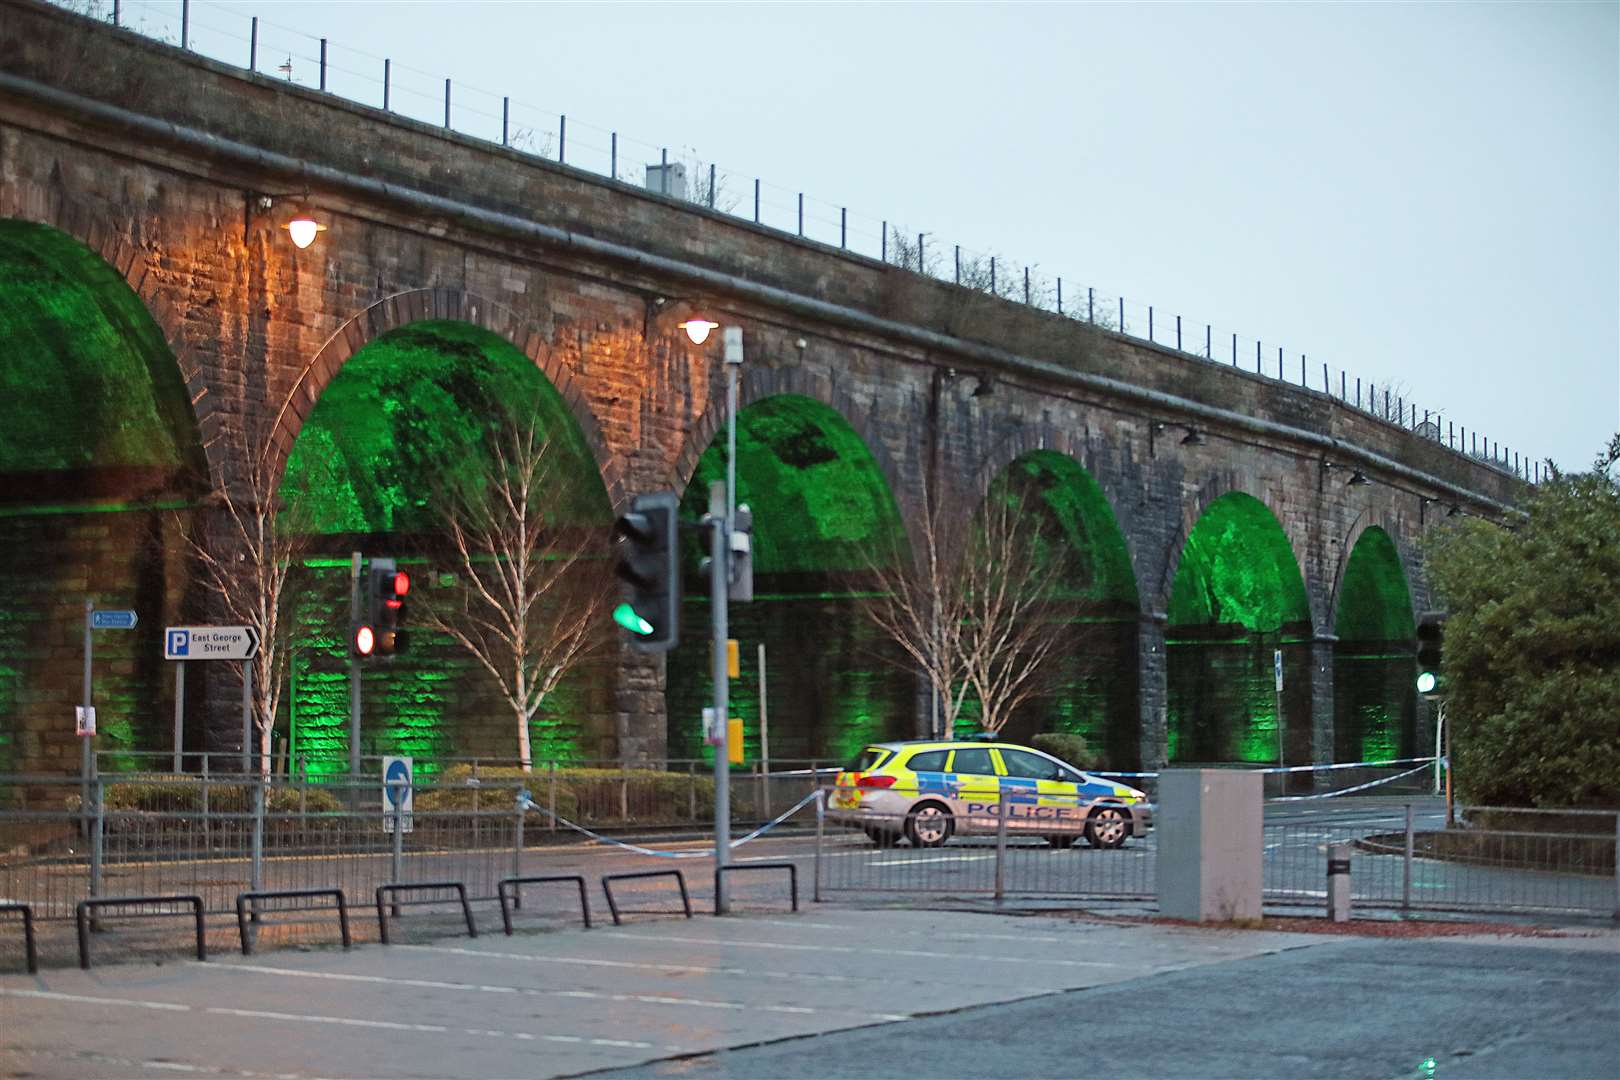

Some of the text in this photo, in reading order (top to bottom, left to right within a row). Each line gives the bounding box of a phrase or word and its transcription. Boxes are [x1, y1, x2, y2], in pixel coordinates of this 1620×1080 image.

[173, 632, 187, 654] P
[192, 634, 242, 643] East George
[204, 643, 231, 652] Street
